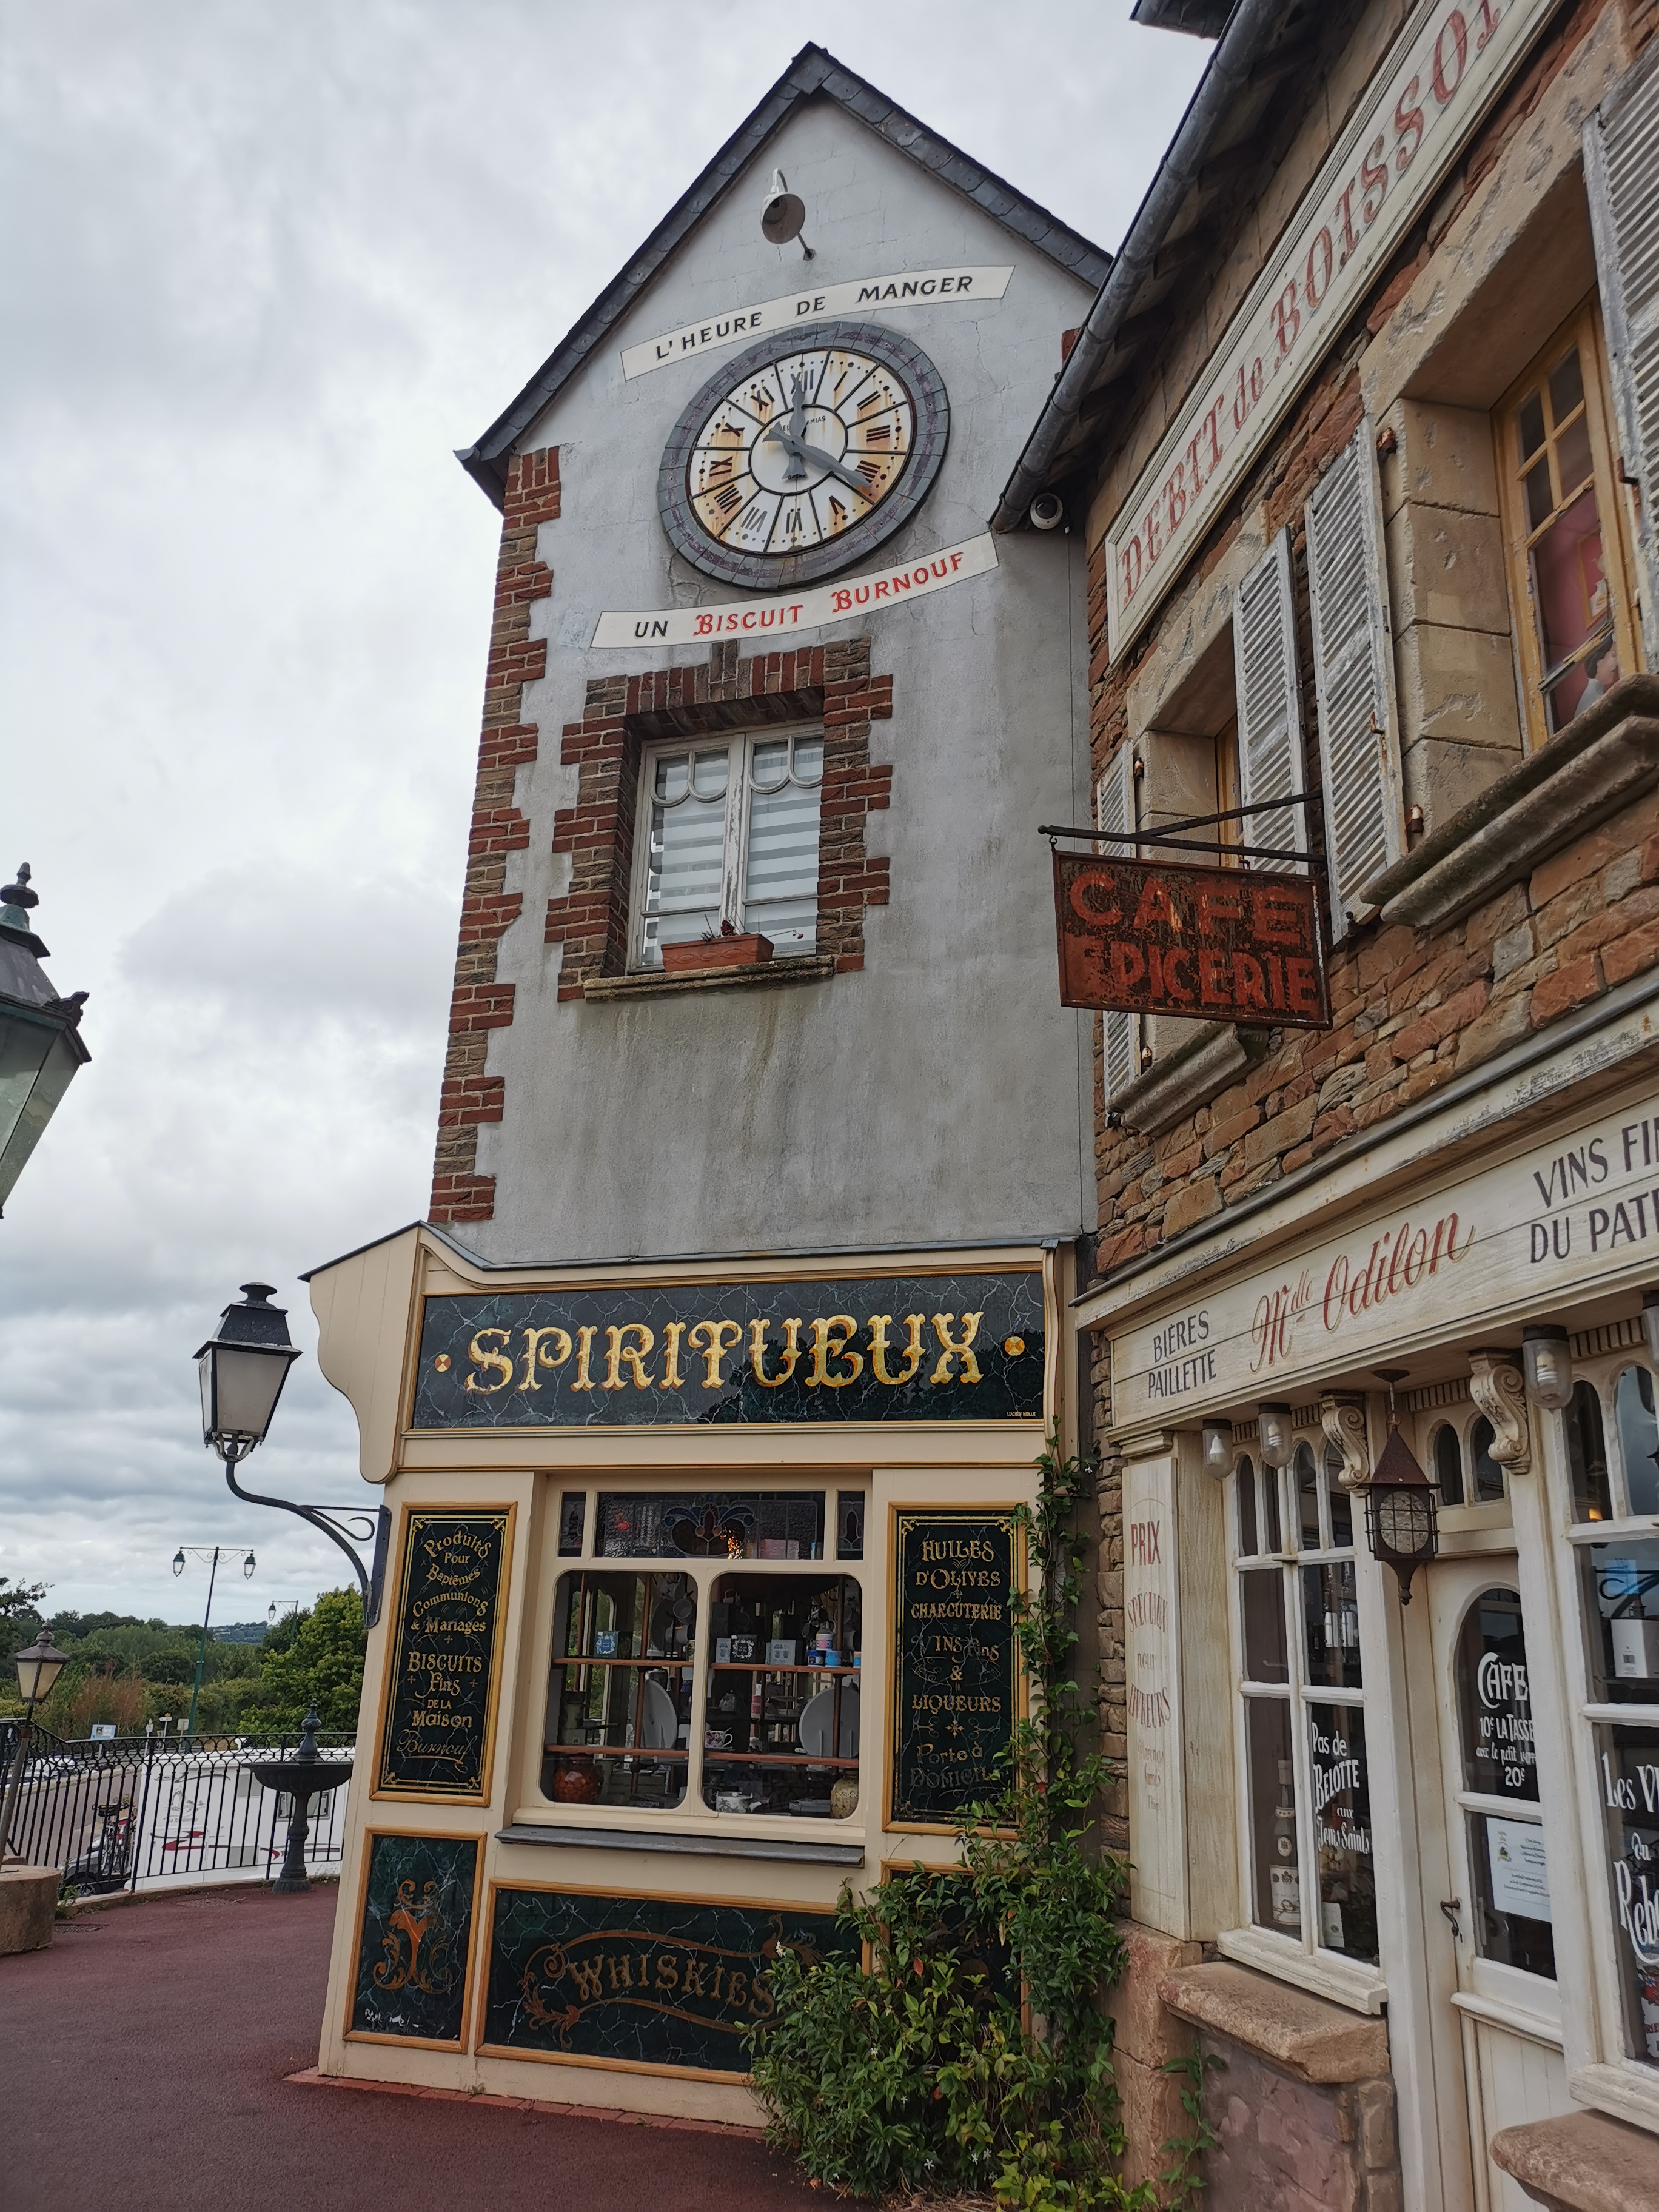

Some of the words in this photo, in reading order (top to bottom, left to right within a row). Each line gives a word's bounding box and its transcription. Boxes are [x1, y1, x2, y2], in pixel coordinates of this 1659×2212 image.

[655, 311, 763, 360] L'HEURE
[795, 296, 826, 317] DE
[856, 275, 973, 303] MANGER
[1233, 357, 1263, 430] de
[635, 620, 669, 638] UN
[692, 604, 805, 637] BISCUIT
[831, 551, 965, 614] BURNOUF
[1069, 871, 1301, 945] CAFE
[1533, 1138, 1608, 1208] VINS
[1530, 1217, 1570, 1263] DU
[1324, 1213, 1474, 1331] Odilon
[463, 1310, 984, 1395] SPIRITUEUX
[1148, 1349, 1216, 1398] PAILLETTE
[424, 1531, 491, 1558] Produits
[922, 1540, 994, 1562] HUILES
[1131, 1520, 1161, 1566] PRIX
[444, 1552, 470, 1564] Pour
[916, 1568, 1000, 1589] D'OLIVES
[413, 1592, 489, 1617] Communions
[911, 1603, 1002, 1620] CHARCUTERIE
[411, 1619, 420, 1630] &
[425, 1616, 486, 1634] Mariages
[407, 1651, 482, 1673] BISCUITS
[950, 1666, 963, 1681] &
[415, 1671, 460, 1698] Fins
[1478, 1652, 1528, 1709] CAFE
[427, 1699, 439, 1709] DE
[440, 1700, 452, 1709] LA
[911, 1695, 1001, 1714] LIQUEURS
[1312, 1722, 1330, 1754] Pas
[1333, 1730, 1347, 1756] de
[1496, 1718, 1508, 1739] LA
[1506, 1714, 1535, 1742] TASSE
[917, 1744, 967, 1765] Porte
[1492, 1741, 1498, 1760] le
[910, 1766, 994, 1788] DOMICIL
[1313, 1759, 1359, 1813] BELOTTE
[1602, 1751, 1636, 1811] Les
[1337, 1807, 1353, 1818] aux
[1341, 1822, 1370, 1854] Saints
[1631, 1832, 1650, 1861] du
[568, 1954, 774, 2018] WHISKIES
